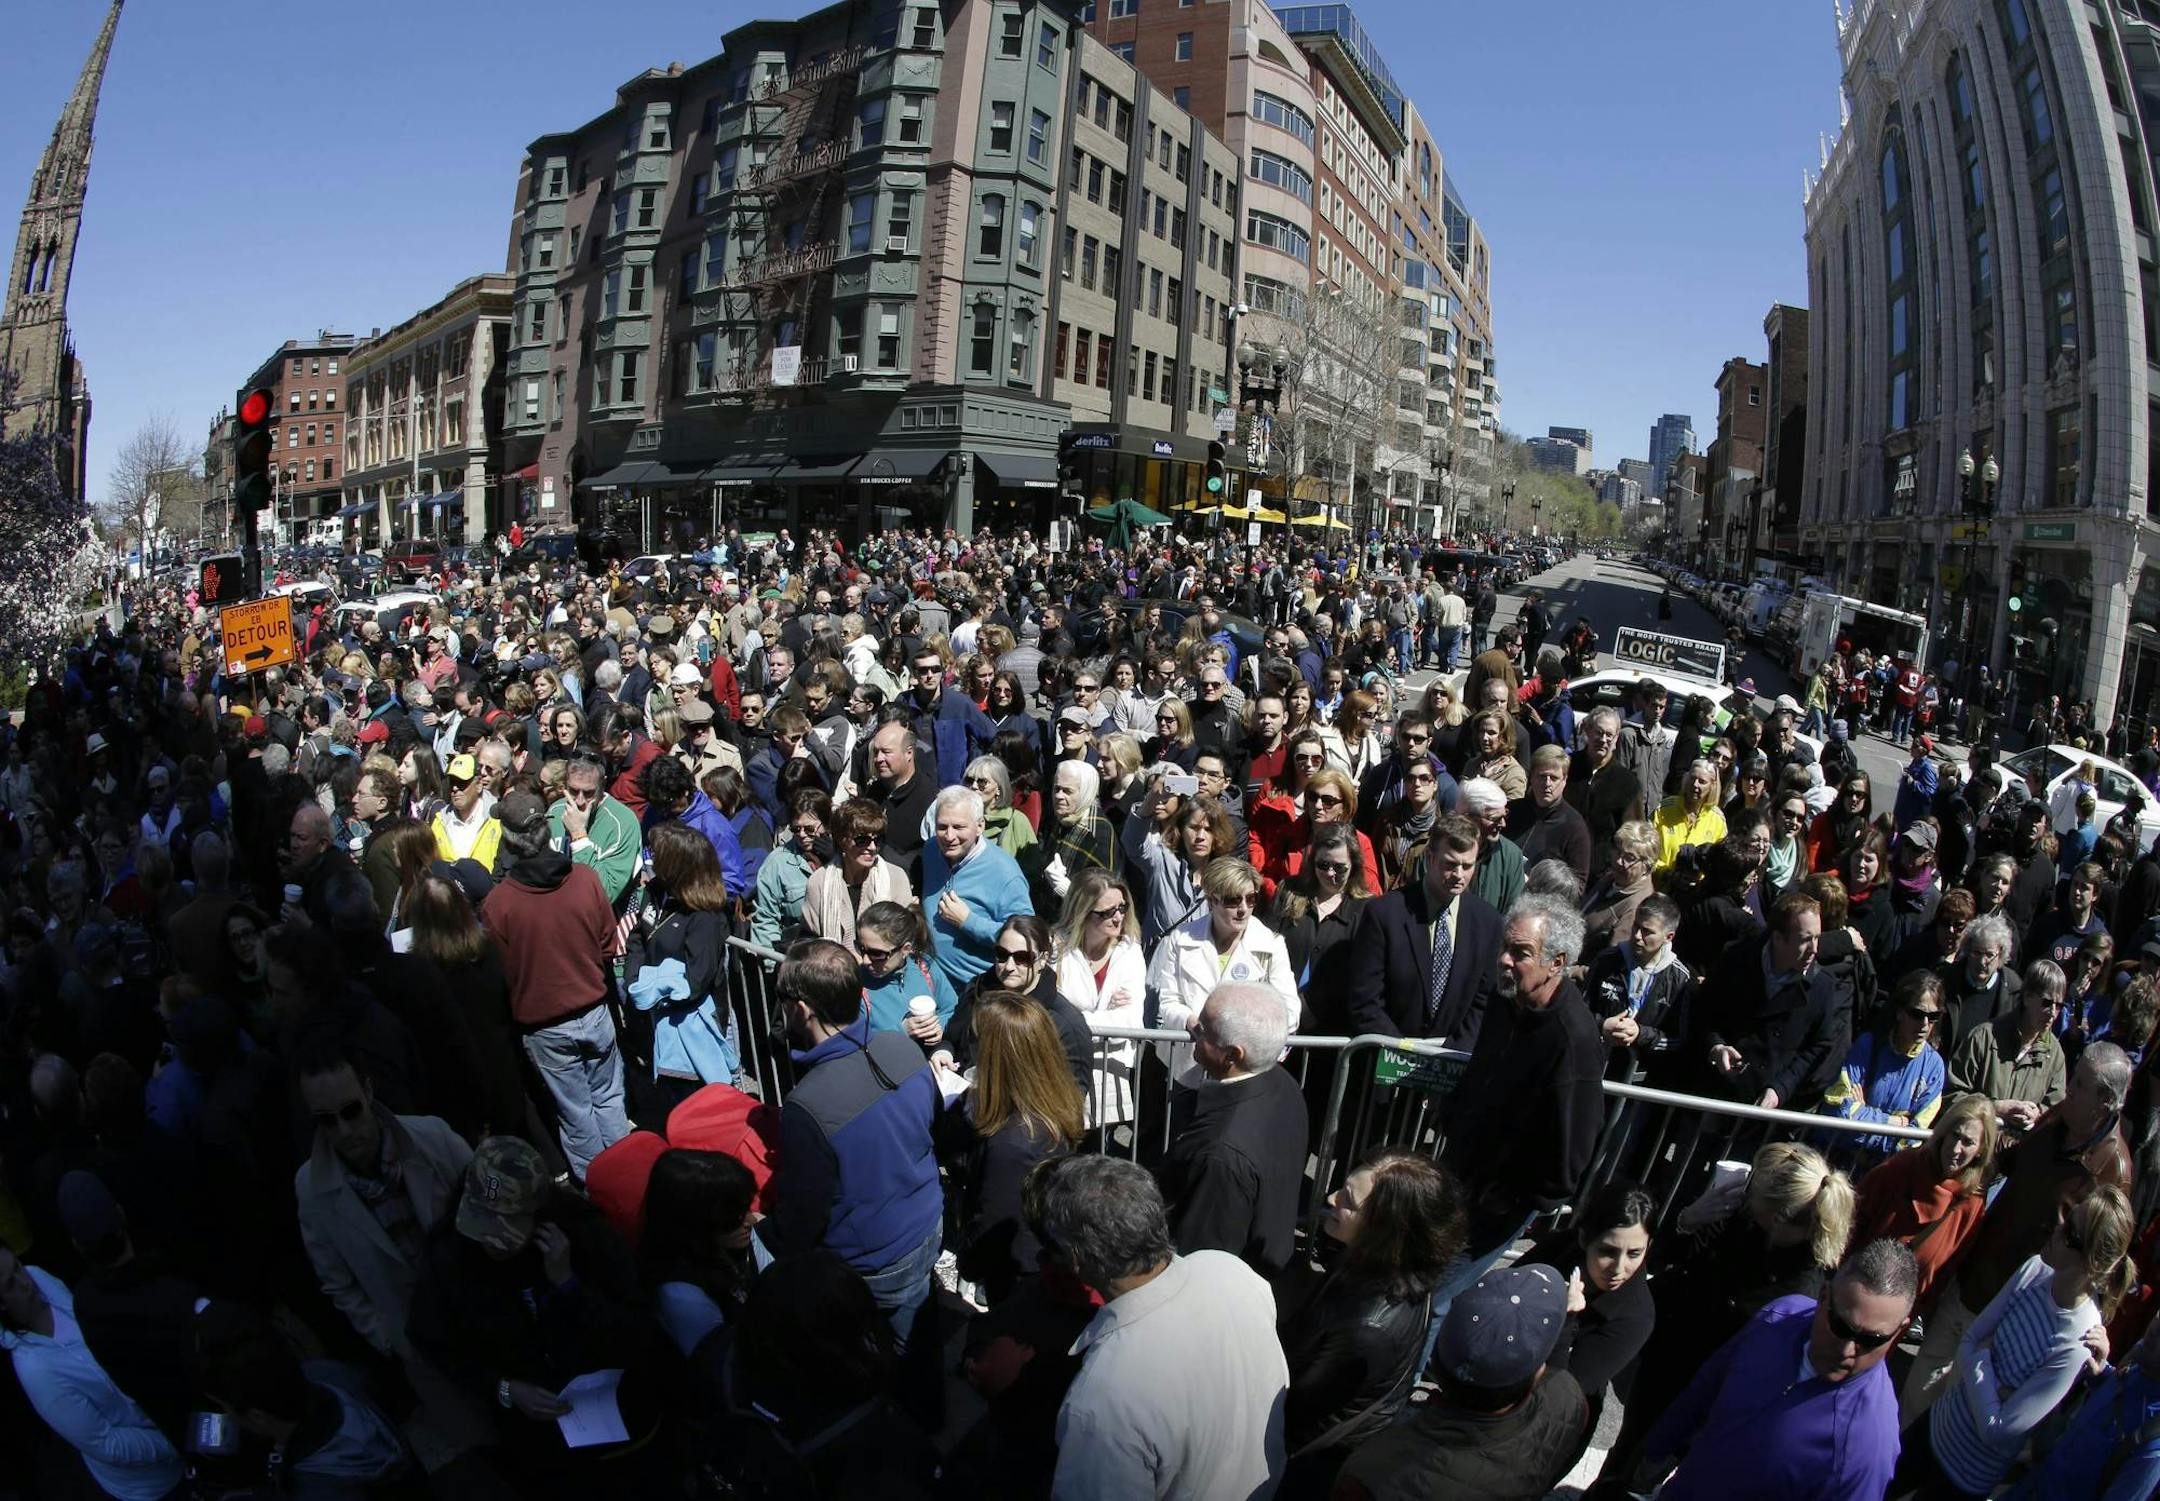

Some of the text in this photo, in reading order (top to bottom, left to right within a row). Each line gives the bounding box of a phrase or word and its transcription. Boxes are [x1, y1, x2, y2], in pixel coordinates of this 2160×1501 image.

[1155, 442, 1173, 454] Berlitz
[1247, 446, 1255, 464] 2013
[229, 603, 267, 620] STORROW
[251, 614, 262, 625] EB
[227, 620, 288, 649] DETOUR
[1620, 628, 1635, 638] THE
[1636, 631, 1657, 642] MOST
[1659, 635, 1694, 649] TRUSTED
[1694, 642, 1721, 654] BRAND
[1618, 637, 1676, 665] LOGIC
